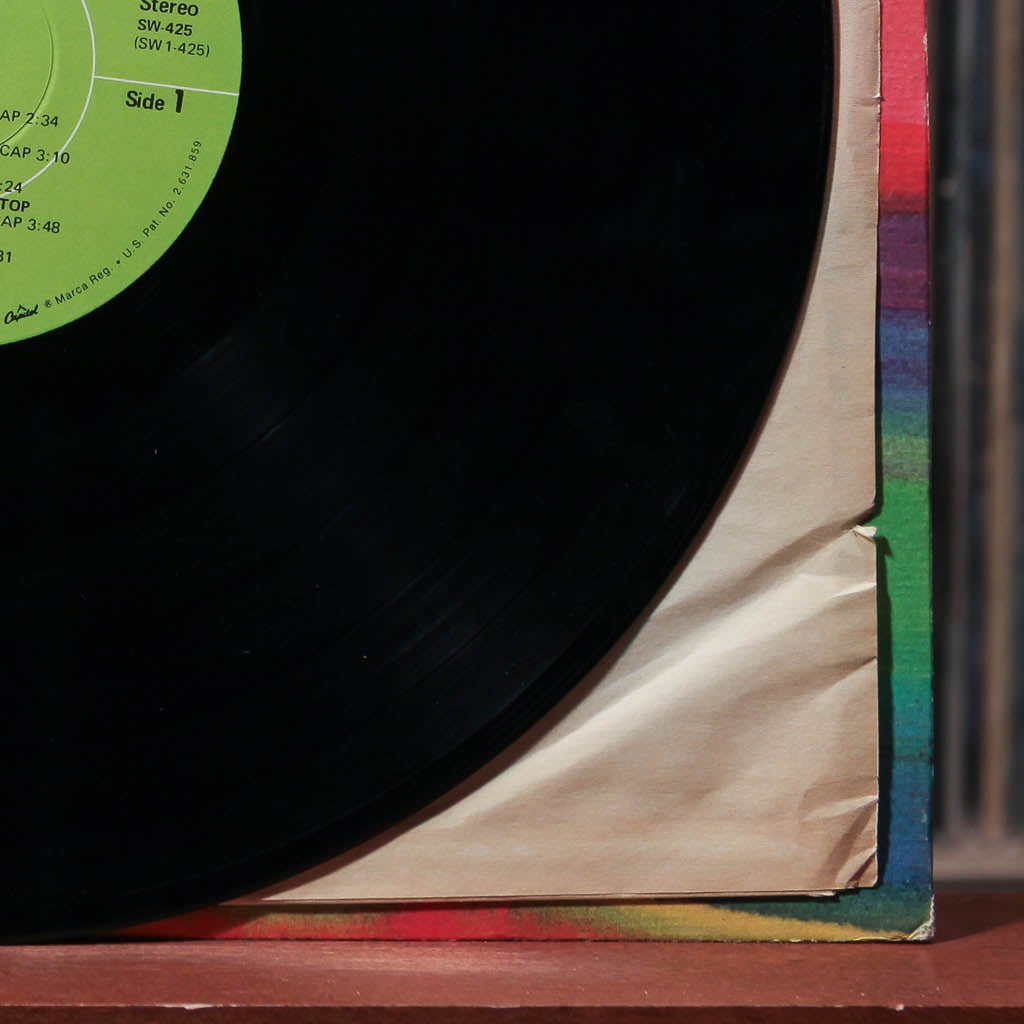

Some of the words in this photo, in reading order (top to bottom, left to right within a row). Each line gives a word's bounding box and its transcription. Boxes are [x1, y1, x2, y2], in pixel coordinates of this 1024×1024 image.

[137, 18, 193, 36] SW-425
[125, 90, 165, 111] Side
[175, 88, 185, 113] 1
[25, 112, 59, 127] 2:34
[36, 149, 70, 164] 3:10
[27, 218, 61, 234] 3:48
[54, 282, 89, 305] Marca
[88, 266, 113, 285] Reg.
[122, 239, 144, 259] U.S.
[158, 200, 176, 217] No.
